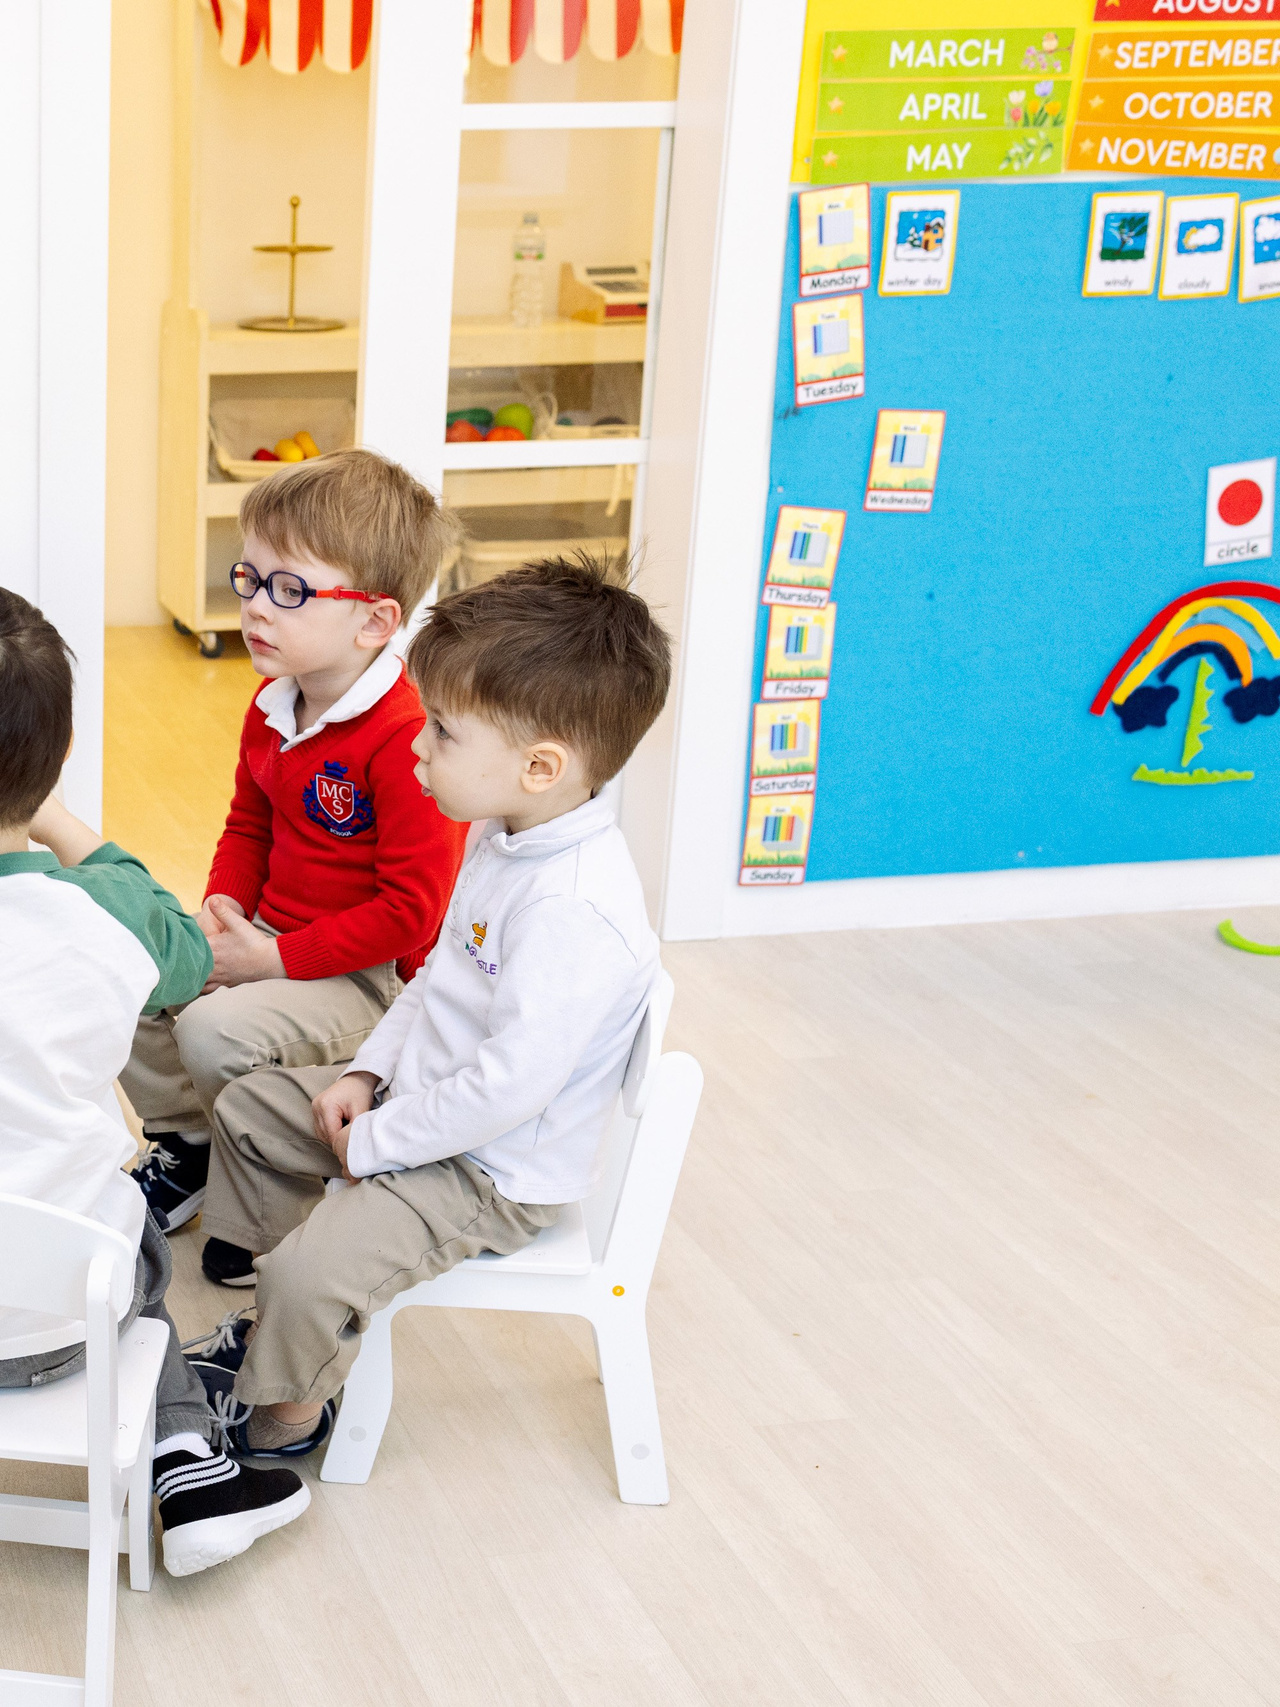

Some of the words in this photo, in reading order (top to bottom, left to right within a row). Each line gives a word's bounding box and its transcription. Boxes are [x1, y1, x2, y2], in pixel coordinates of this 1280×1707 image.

[888, 39, 1006, 69] MARCH
[898, 92, 987, 121] APRIL
[1123, 91, 1273, 120] OCTOBER
[905, 142, 972, 173] MAY
[1097, 137, 1267, 172] NOVEMBER
[809, 273, 861, 291] Monday
[923, 275, 942, 289] day
[803, 380, 859, 398] Tuesday
[869, 493, 928, 507] Wednesday
[1217, 541, 1259, 559] circle
[768, 587, 826, 606] Thursday
[774, 682, 816, 699] Friday
[754, 776, 813, 793] Saturday
[749, 869, 796, 884] Sunday
